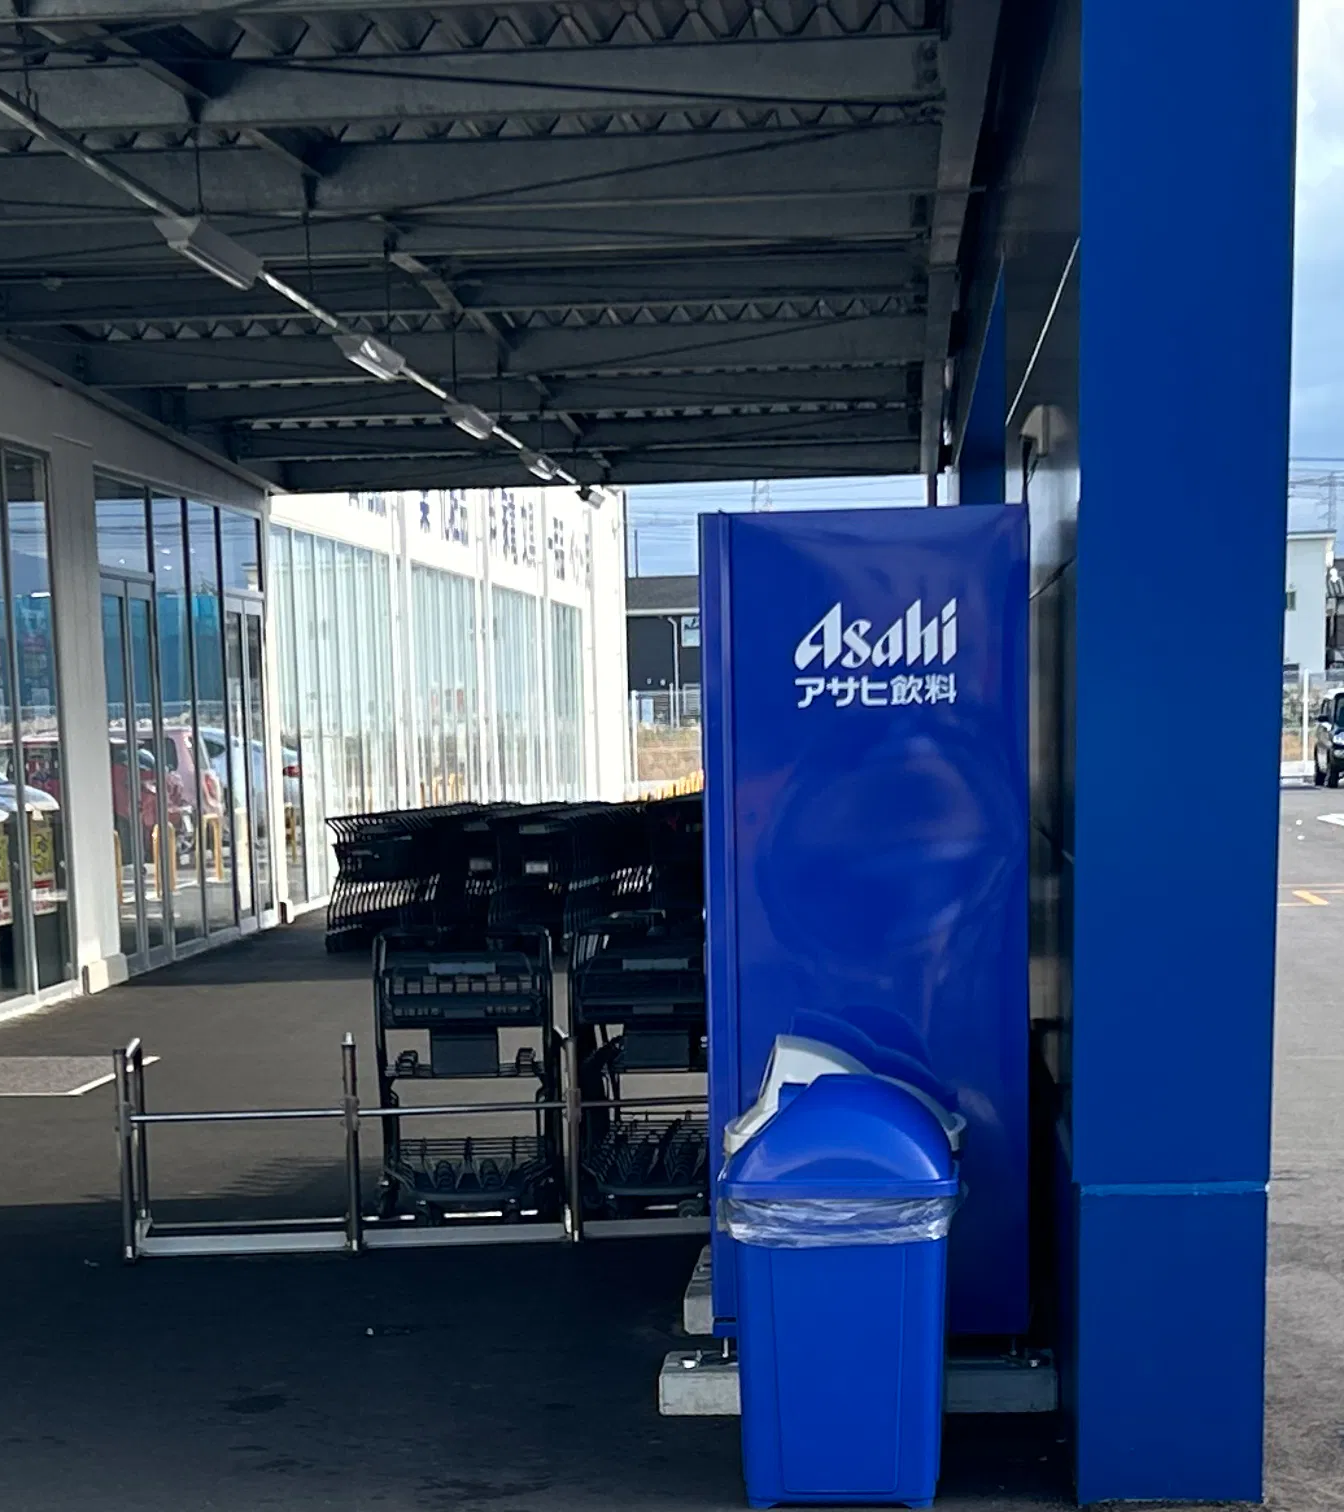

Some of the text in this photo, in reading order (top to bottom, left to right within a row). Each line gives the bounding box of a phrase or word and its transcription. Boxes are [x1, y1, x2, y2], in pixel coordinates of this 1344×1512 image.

[793, 596, 959, 672] Asahi
[793, 672, 958, 709] アサヒ飲料
